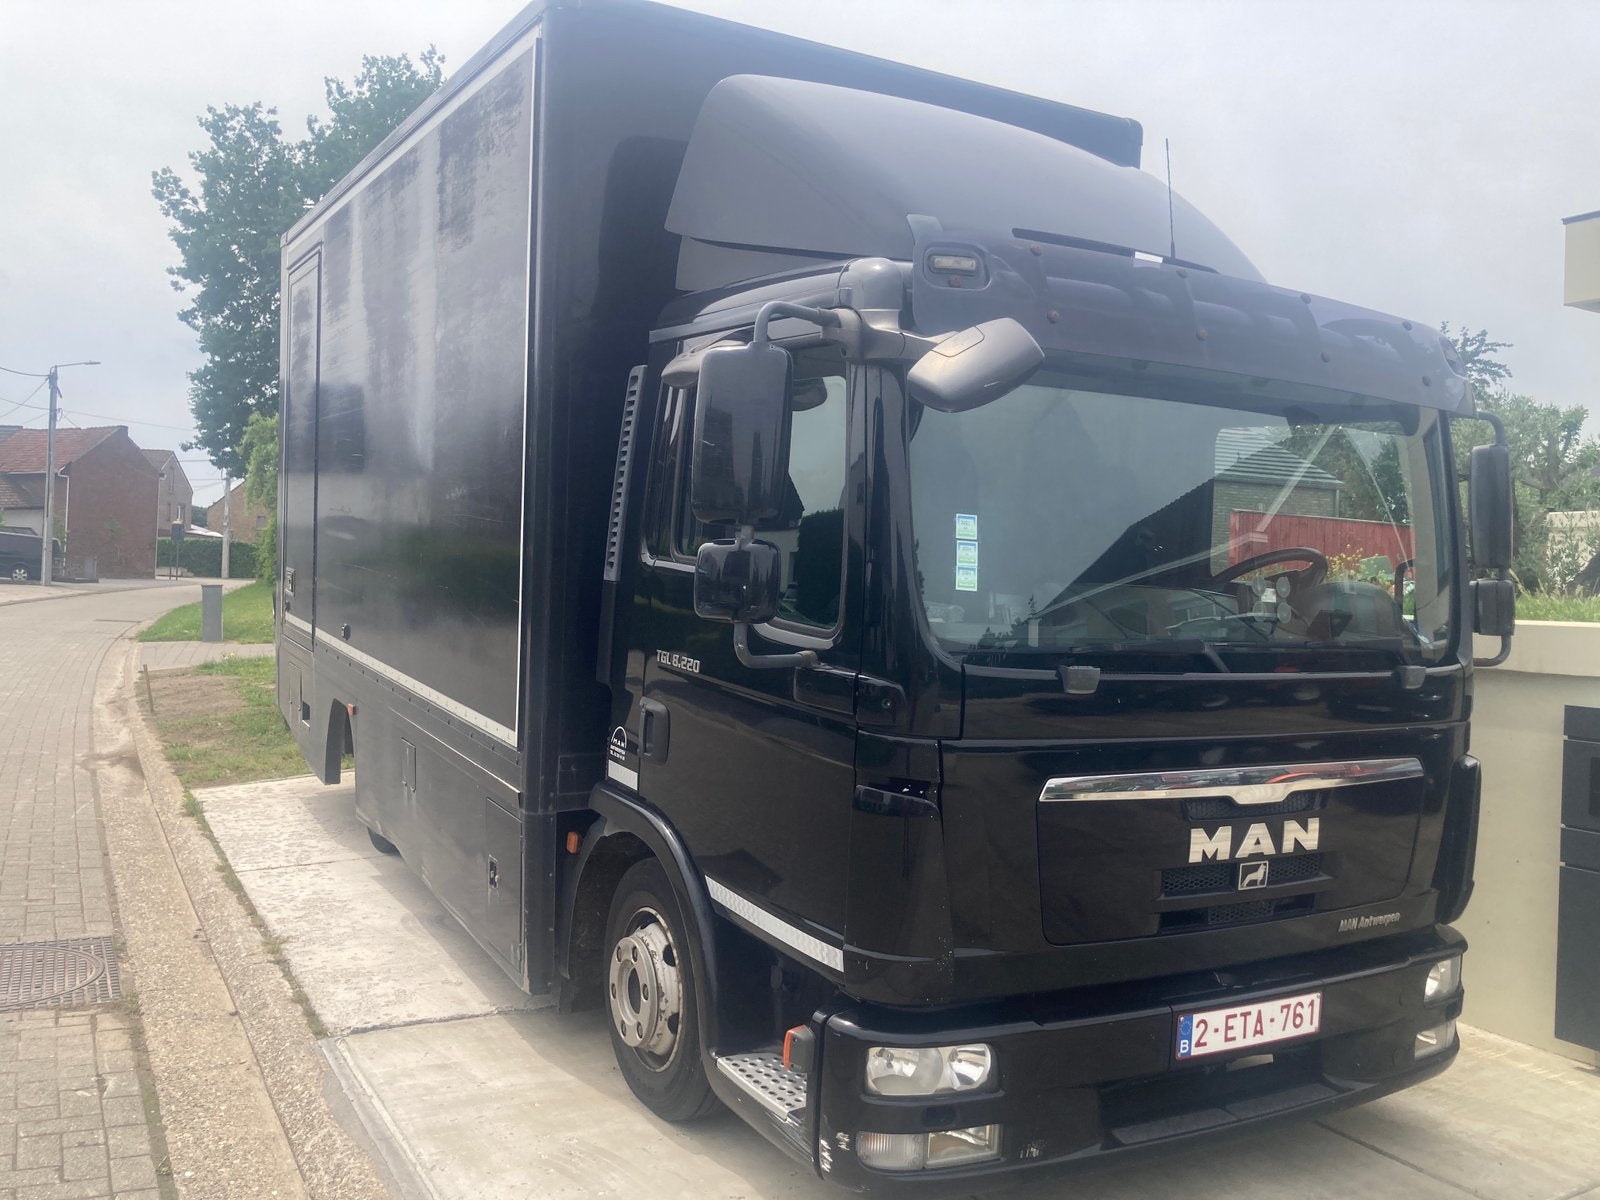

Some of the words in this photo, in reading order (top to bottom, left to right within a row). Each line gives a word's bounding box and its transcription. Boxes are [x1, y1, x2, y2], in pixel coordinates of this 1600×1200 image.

[656, 649, 671, 665] TGL
[672, 654, 701, 673] 8.220
[1189, 817, 1320, 863] MAN
[1338, 917, 1358, 932] MAN
[1358, 912, 1400, 929] Antwerpen
[1194, 999, 1316, 1048] 2-ETA-761
[1180, 1039, 1189, 1053] B
